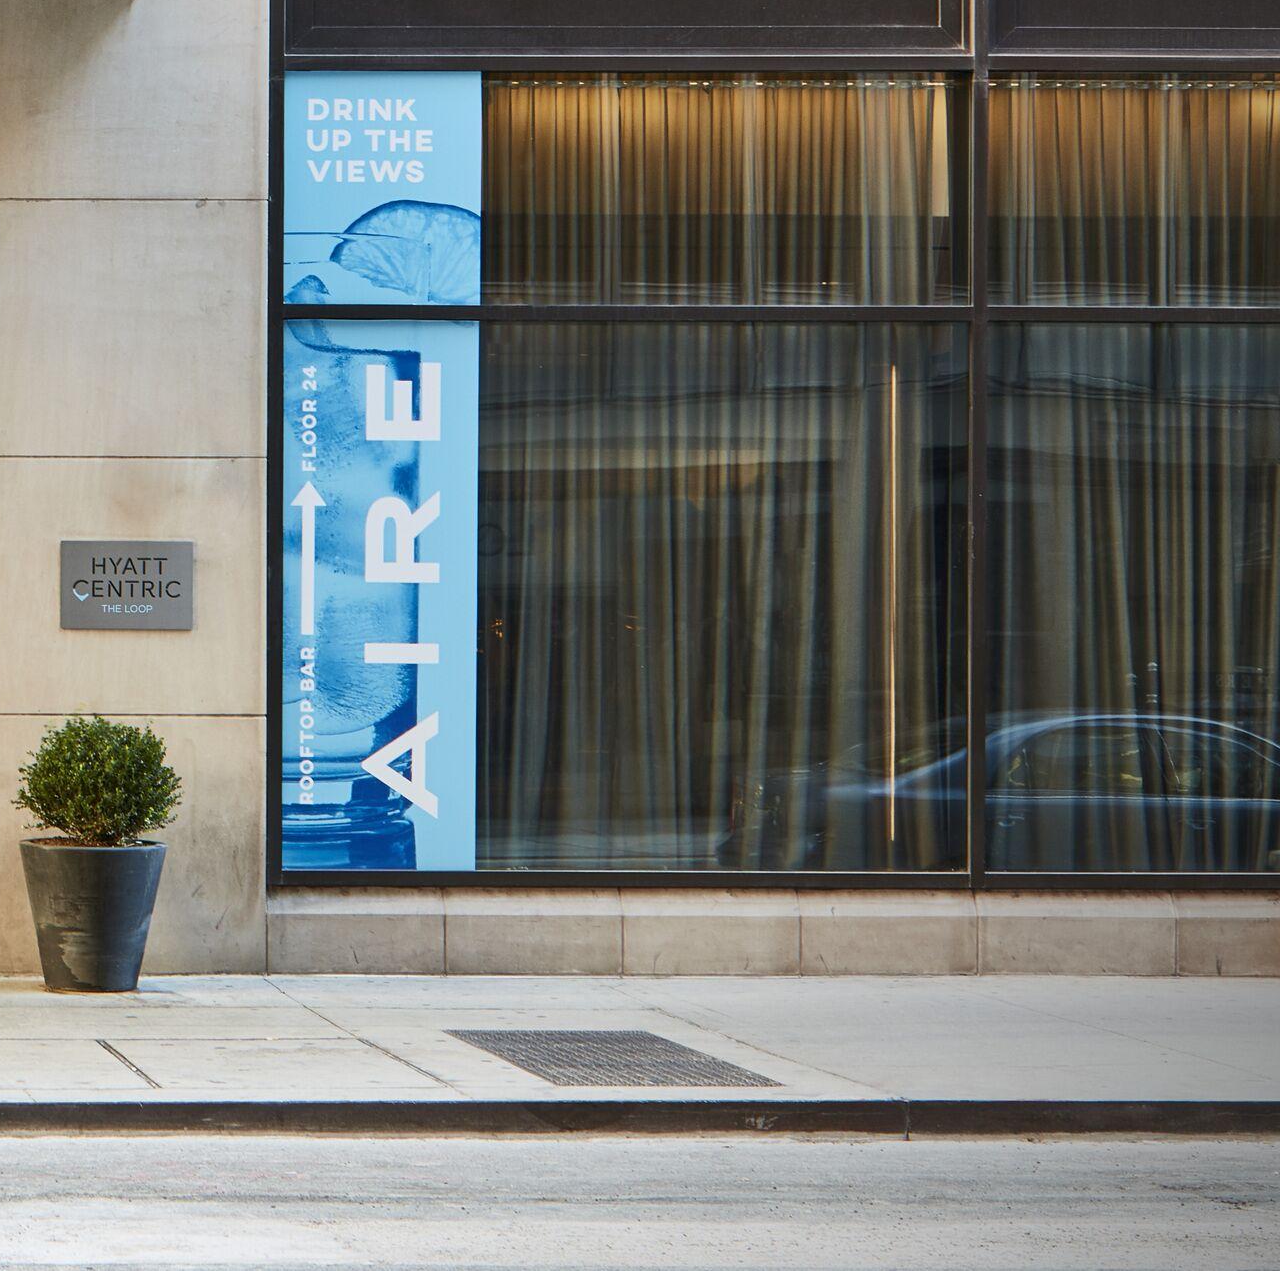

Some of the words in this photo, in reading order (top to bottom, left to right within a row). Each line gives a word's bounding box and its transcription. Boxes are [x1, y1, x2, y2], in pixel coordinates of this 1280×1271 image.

[306, 98, 418, 121] DRINK
[306, 129, 351, 152] UP
[364, 129, 434, 152] THE
[306, 160, 425, 183] VIEWS
[301, 365, 317, 391] 24
[301, 399, 317, 472] FLOOR
[91, 557, 168, 575] HYATT
[72, 579, 181, 601] CENTRIC
[361, 361, 442, 820] AIRE
[101, 604, 122, 613] THE
[124, 604, 153, 613] LOOP
[299, 646, 315, 692] BAR
[299, 698, 315, 805] ROOFTOP
